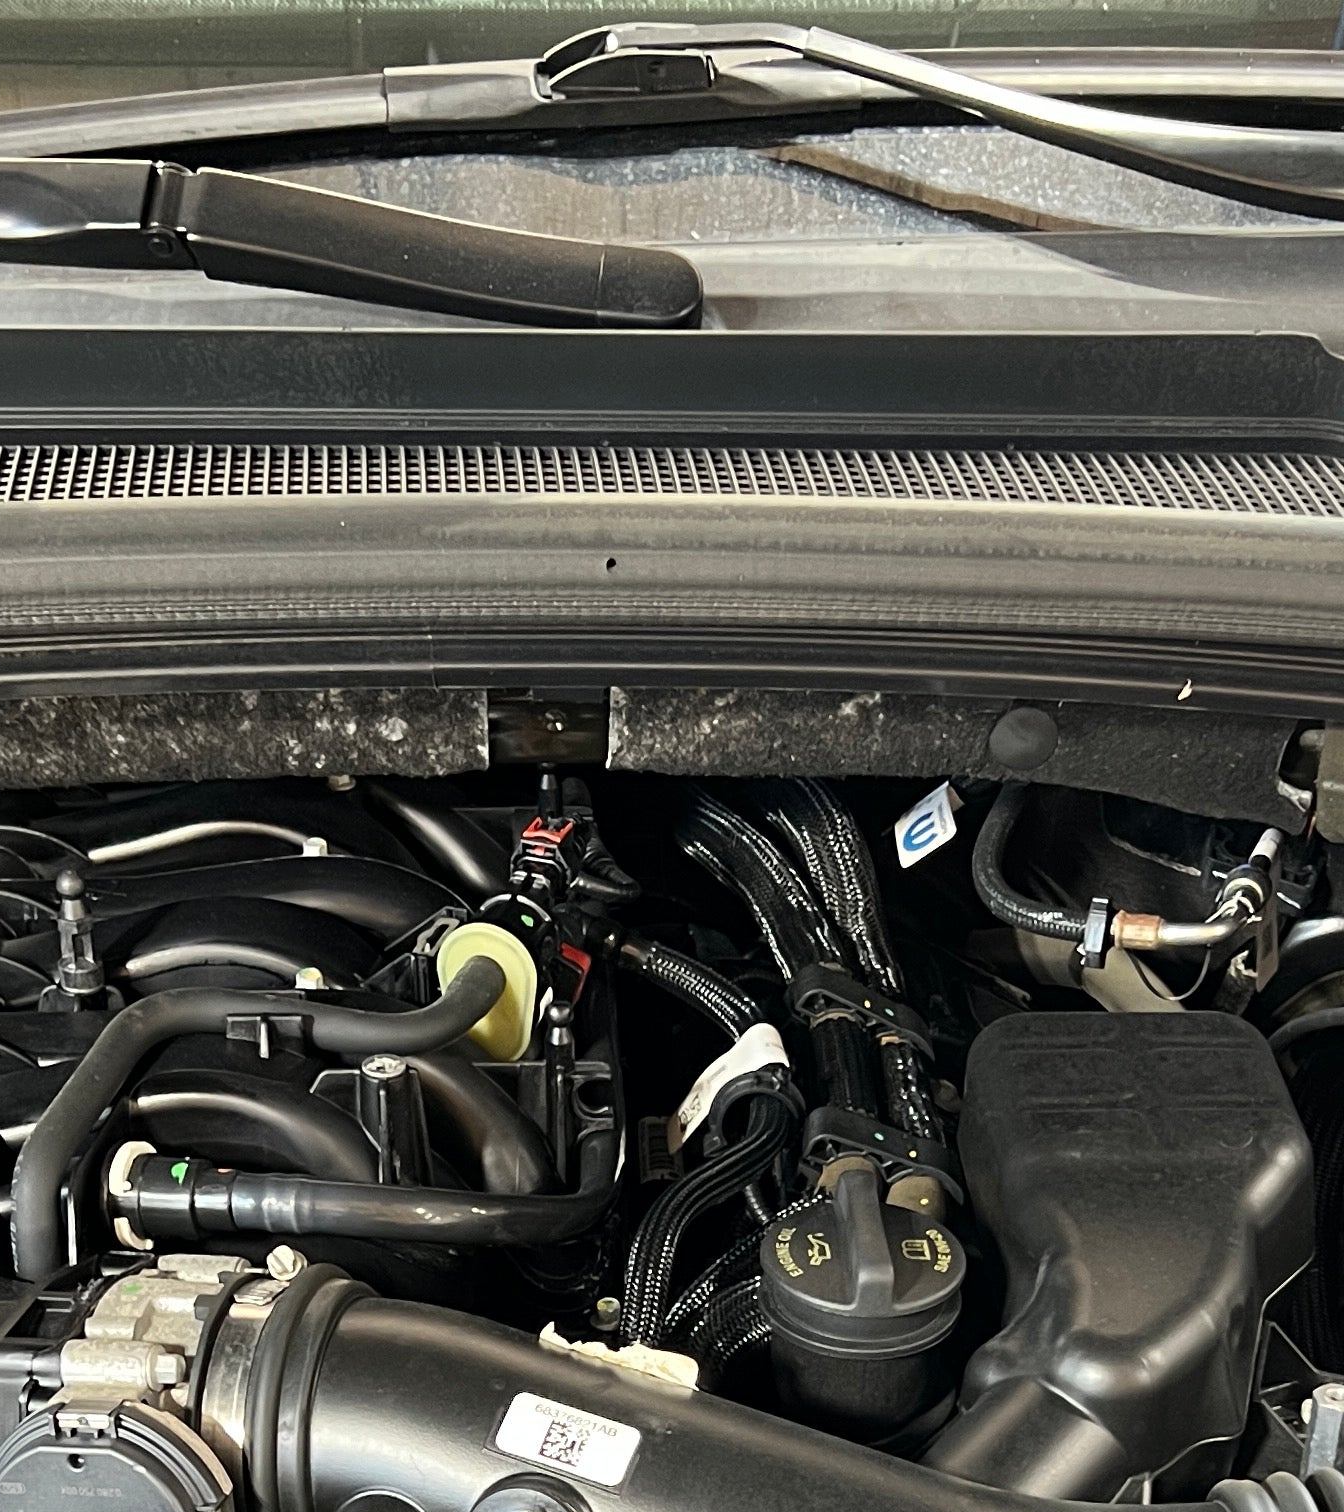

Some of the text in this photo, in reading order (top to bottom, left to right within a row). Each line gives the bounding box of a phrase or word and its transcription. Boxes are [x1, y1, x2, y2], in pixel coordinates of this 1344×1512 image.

[775, 1227, 804, 1278] ENGINE OIL
[933, 1254, 952, 1273] SAE
[534, 1403, 619, 1438] 68376821AB
